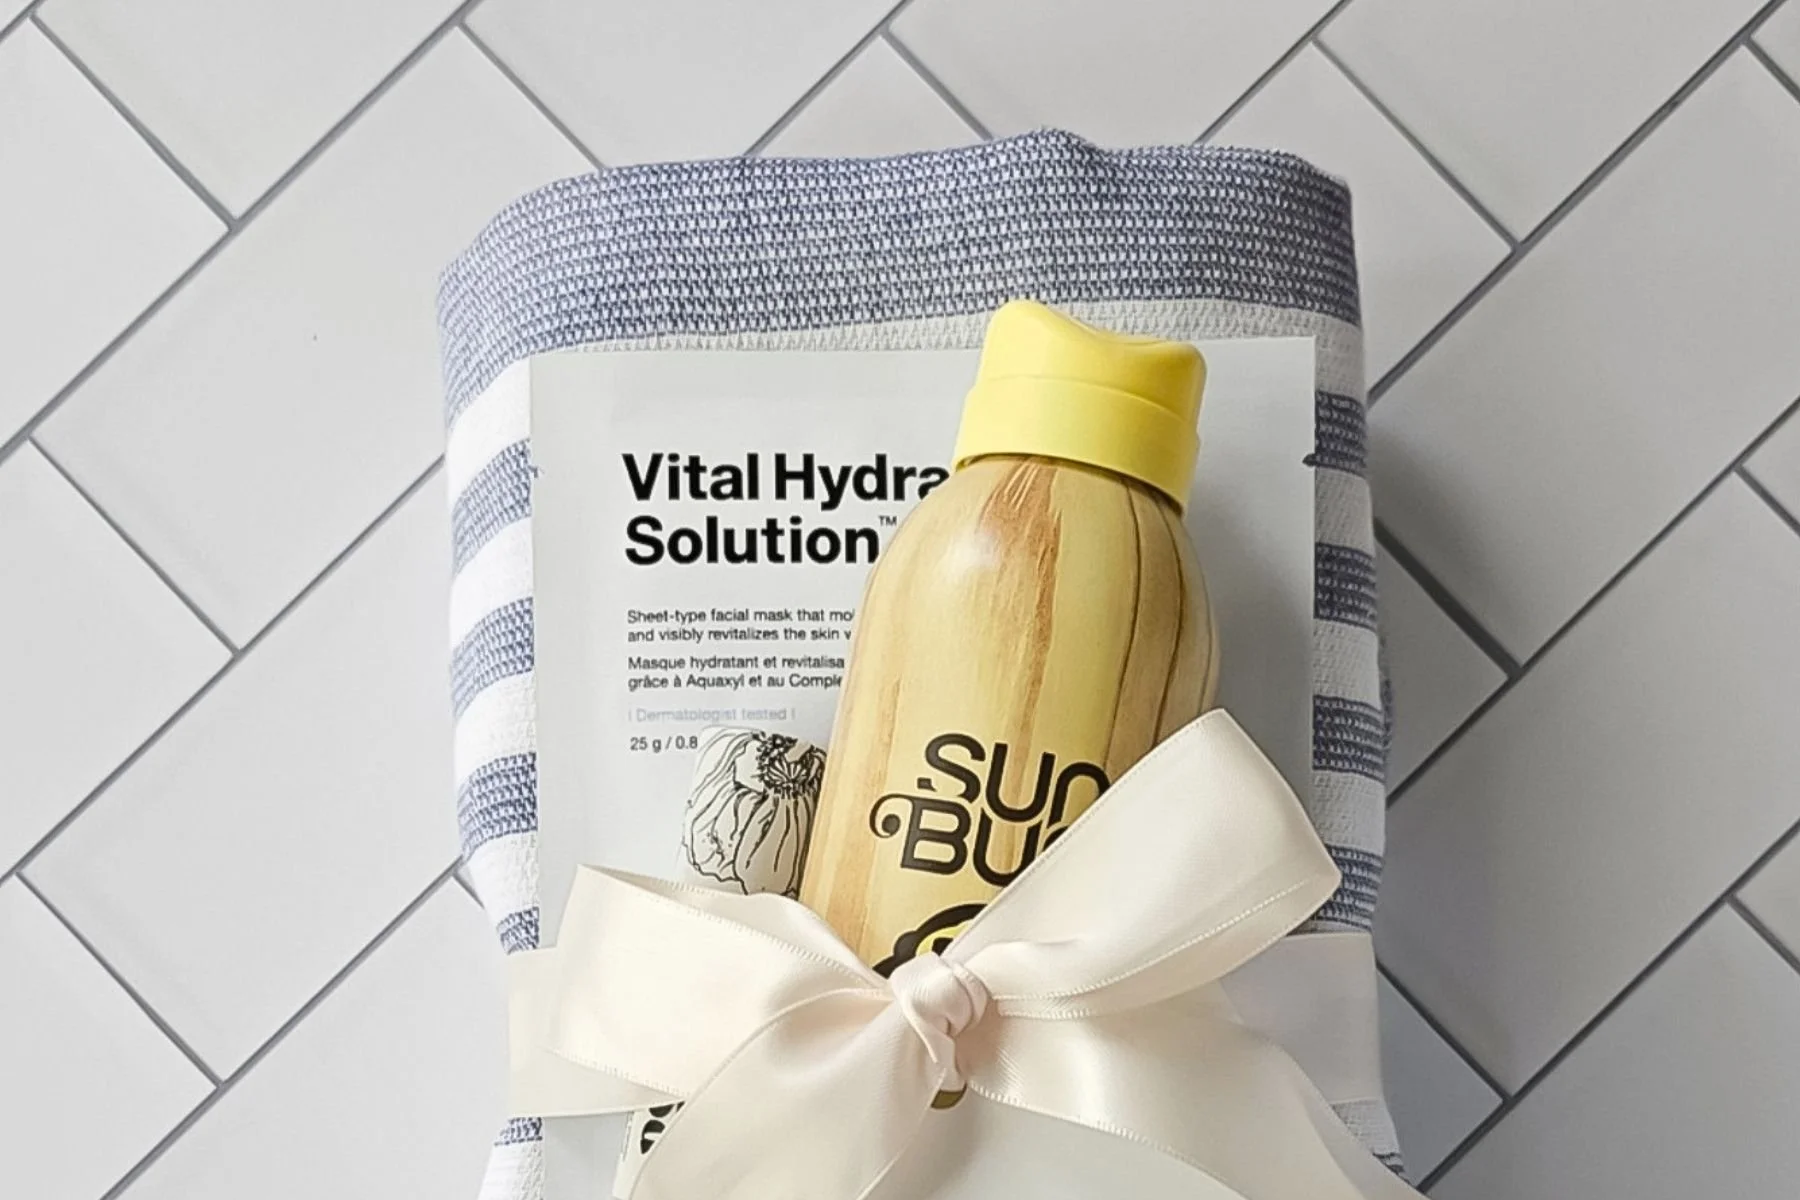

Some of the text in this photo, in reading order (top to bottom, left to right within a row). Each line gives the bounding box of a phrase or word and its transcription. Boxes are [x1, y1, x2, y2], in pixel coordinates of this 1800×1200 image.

[622, 453, 759, 501] Vital
[627, 608, 855, 625] Sheet-type facial mask that mo
[627, 628, 654, 642] and
[659, 628, 703, 643] visibly
[708, 628, 779, 641] revitalizes
[784, 628, 806, 640] the
[810, 628, 840, 640] skin
[628, 656, 845, 671] Masque hydratant et revitalisa
[628, 675, 669, 692] grâce
[673, 675, 682, 688] à
[686, 674, 745, 690] Aquaxyl
[749, 675, 762, 687] et
[767, 676, 785, 688] au
[636, 708, 787, 722] Dermatologist tested
[630, 736, 698, 753] 25 g / 0.8
